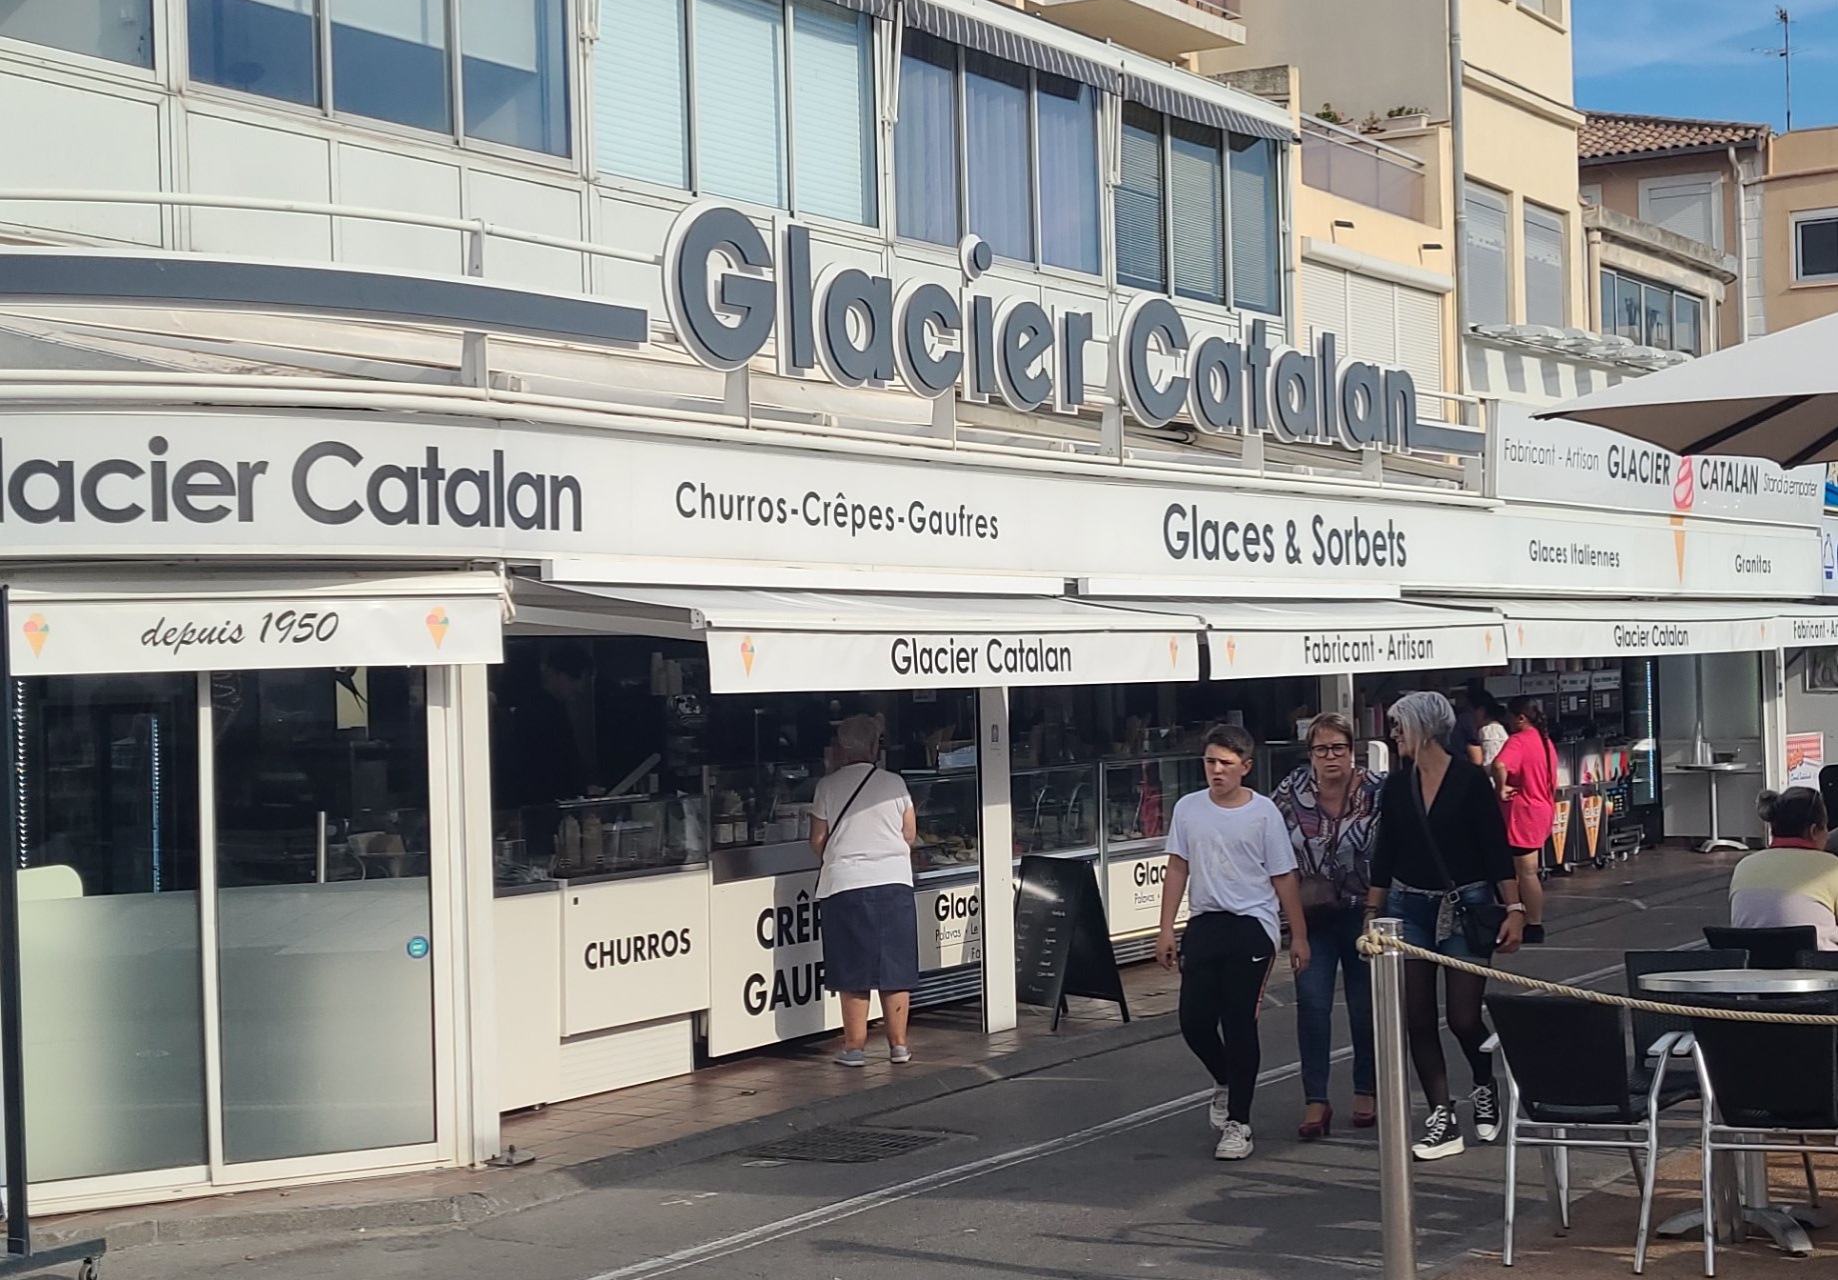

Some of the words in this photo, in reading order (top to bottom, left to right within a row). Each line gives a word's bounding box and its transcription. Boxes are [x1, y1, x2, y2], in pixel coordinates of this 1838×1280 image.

[664, 202, 1095, 411] Glacier
[1120, 295, 1417, 451] Catalan
[292, 441, 583, 532] Catalan
[1505, 438, 1556, 466] Fabricant
[1565, 446, 1599, 471] Artisan
[1608, 444, 1672, 486] GLACIER
[1700, 458, 1759, 496] CATALAN
[676, 481, 999, 540] Churros-Crêpes-Gaufres
[1164, 503, 1275, 563] Glaces
[1286, 519, 1303, 564] &
[1312, 514, 1407, 567] Sorbets
[1529, 540, 1568, 565] Glaces
[1571, 542, 1620, 568] Italiennes
[1735, 554, 1771, 574] Granitas
[141, 616, 245, 656] depuis
[259, 609, 339, 644] 1950
[1304, 635, 1375, 665] Fabricant
[1387, 634, 1434, 662] Artisan
[1614, 625, 1650, 649] Glacier
[1652, 624, 1689, 648] Catalan
[1793, 621, 1826, 640] Fabricant
[891, 637, 979, 676] Glacier
[986, 637, 1072, 674] Catalan
[1133, 861, 1167, 887] Glac
[756, 889, 822, 950] CRÊP
[934, 893, 979, 922] Glac
[584, 928, 692, 970] CHURROS
[935, 926, 961, 942] Palavas
[743, 961, 836, 1016] GAUF
